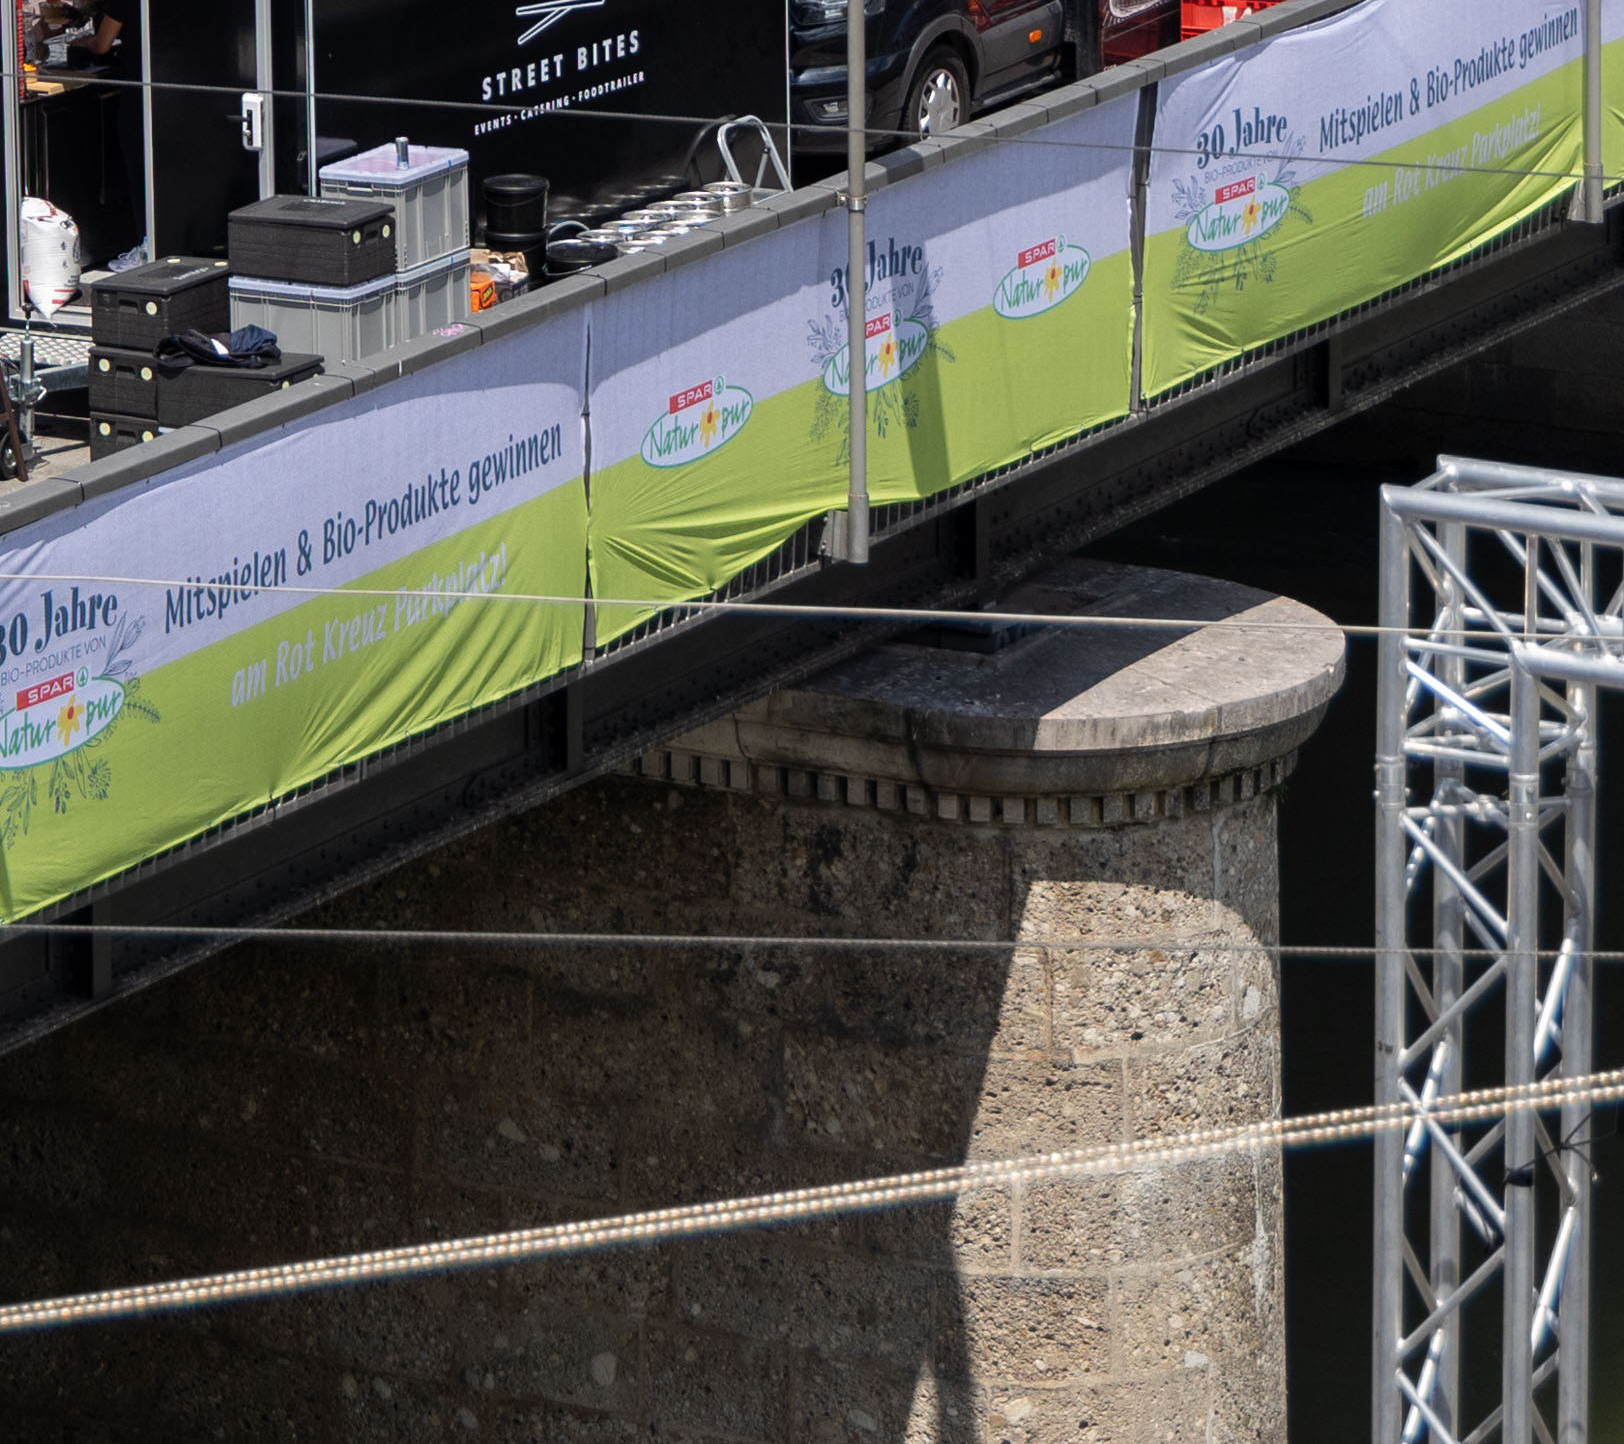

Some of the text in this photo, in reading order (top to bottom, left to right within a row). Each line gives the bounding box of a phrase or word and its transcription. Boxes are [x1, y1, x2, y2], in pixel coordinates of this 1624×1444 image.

[481, 29, 640, 102] STREET BITES
[1317, 6, 1579, 154] Mitspielen & Bio-Produkte gewinnen
[473, 70, 646, 137] EVENTS CATERING FOODTRAILER
[1195, 107, 1288, 170] 30 Jahre
[1361, 101, 1542, 219] am Rot Kreuz Parkplatz!
[1221, 179, 1256, 201] SPAR
[1194, 194, 1288, 247] Natur pur
[999, 253, 1091, 312] Natur pur
[1023, 242, 1056, 265] SPAR
[899, 285, 916, 303] VON
[865, 316, 892, 338] PAR
[676, 382, 713, 410] SPAR
[650, 398, 752, 459] Natur pur
[162, 422, 564, 635] Mitspielen & Bio-Produkte gewinnen
[34, 585, 119, 654] Jahre
[231, 541, 509, 710] am Rot Kreuz Parkplatz!
[0, 634, 108, 687] BIO-PRODUKTE VON
[27, 675, 74, 705] SPAR
[85, 690, 122, 735] pur
